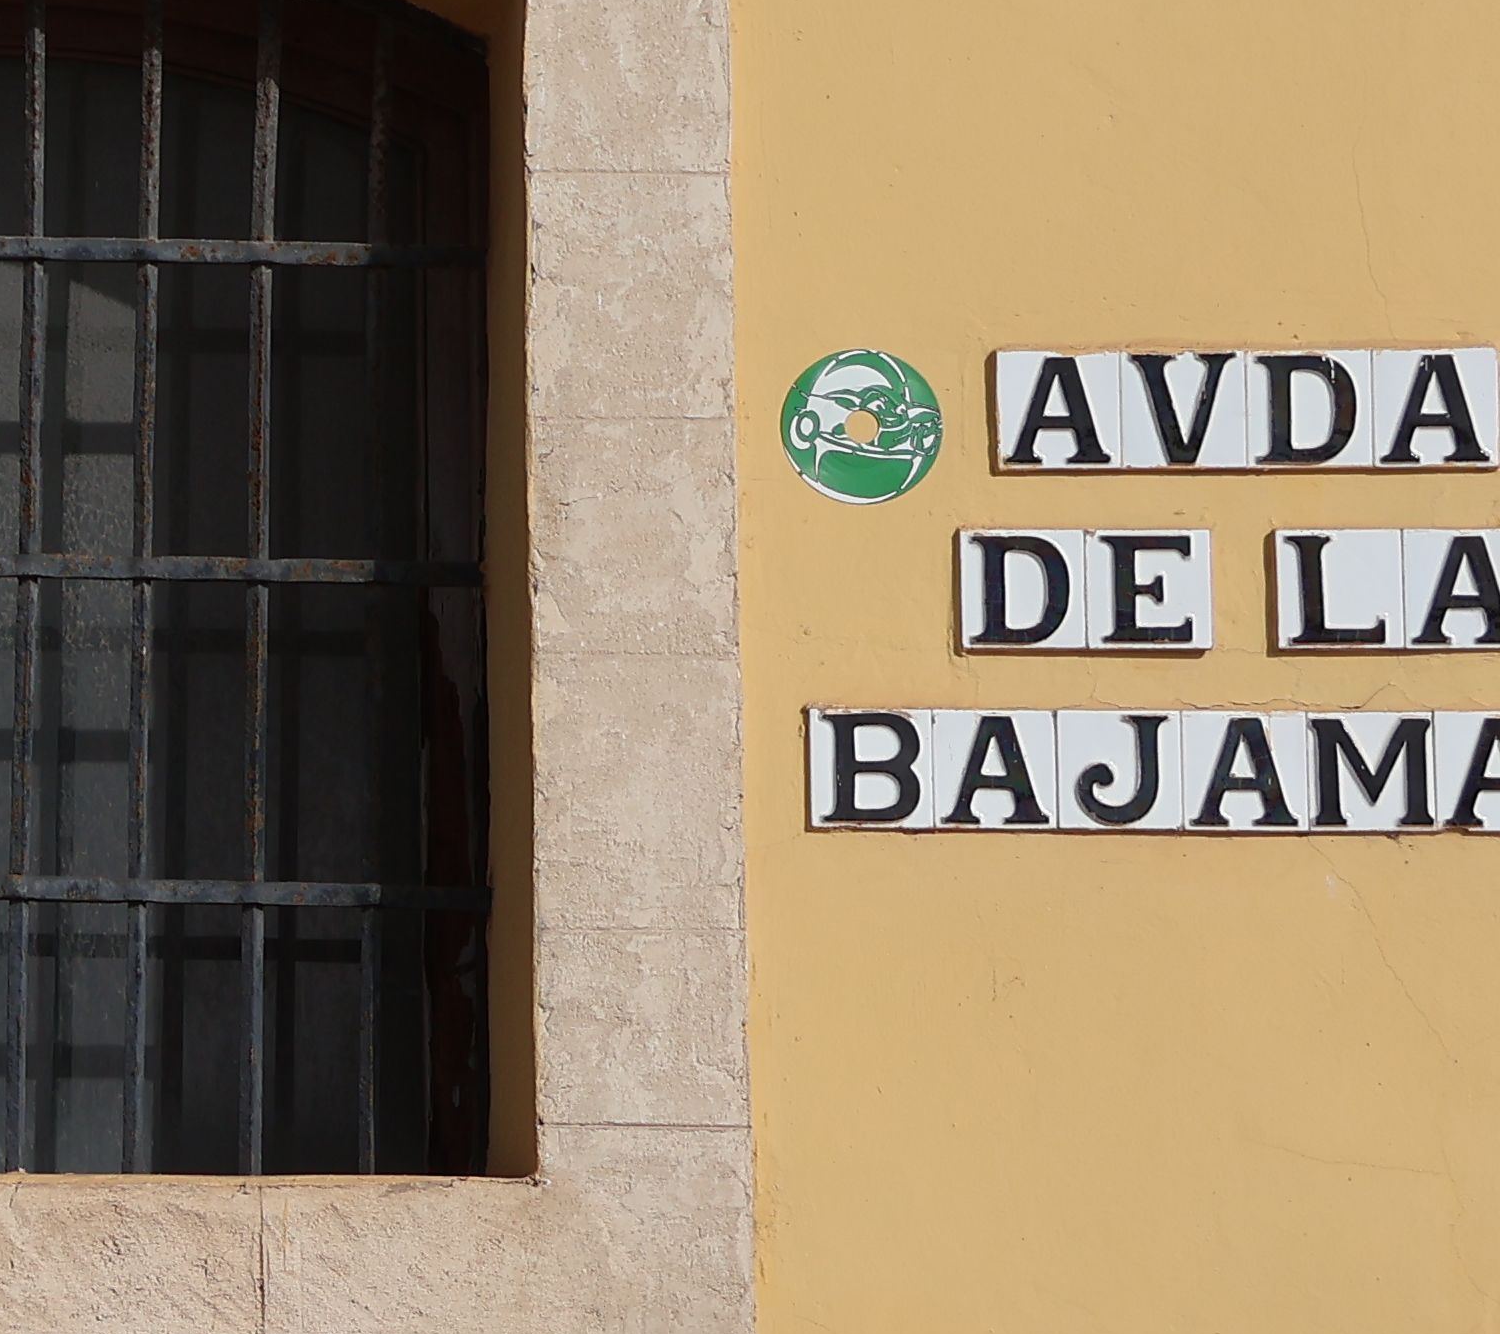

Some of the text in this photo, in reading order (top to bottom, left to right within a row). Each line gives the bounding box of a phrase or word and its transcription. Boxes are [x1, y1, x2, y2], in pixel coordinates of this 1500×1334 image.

[1004, 352, 1490, 466] AVDA
[969, 534, 1500, 646] DE LA
